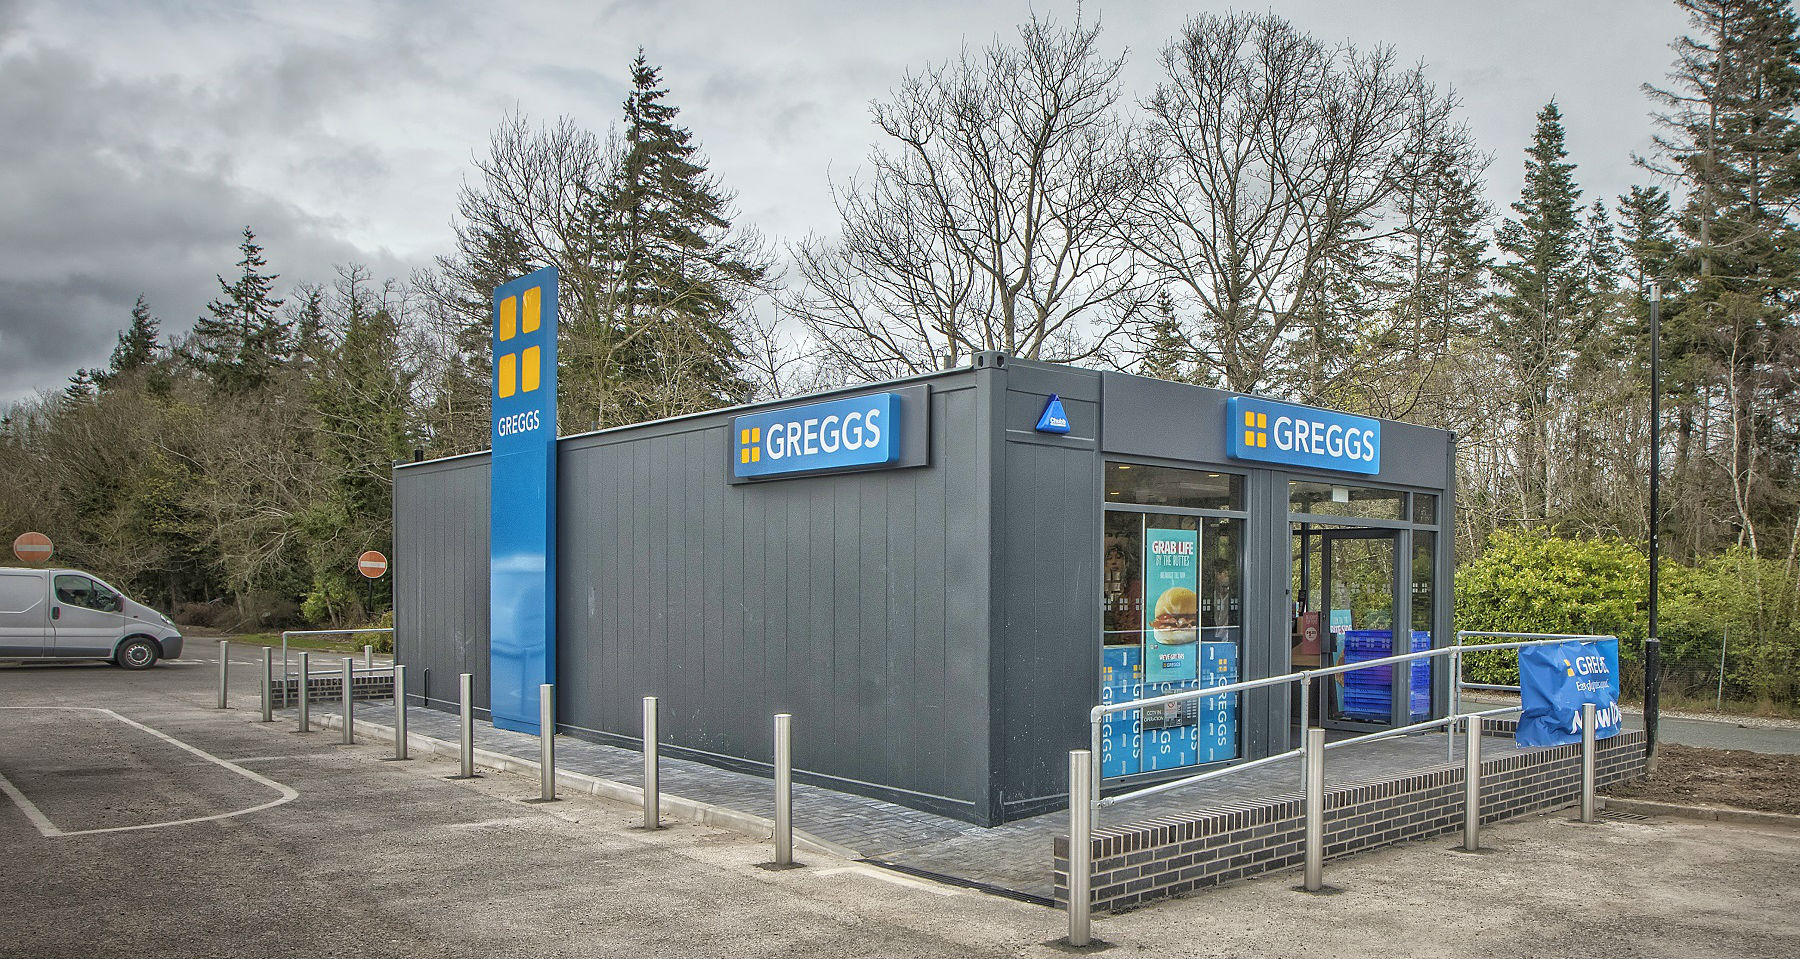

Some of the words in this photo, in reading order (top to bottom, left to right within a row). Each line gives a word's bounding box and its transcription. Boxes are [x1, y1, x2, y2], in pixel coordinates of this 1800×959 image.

[498, 409, 540, 437] GREGGS
[766, 408, 881, 460] GREGGS
[1273, 416, 1375, 462] GREGGS
[1152, 540, 1177, 555] GRAB
[1178, 541, 1194, 555] LIFE
[1155, 554, 1162, 567] BY
[1163, 554, 1172, 567] THE
[1570, 709, 1611, 734] NW
